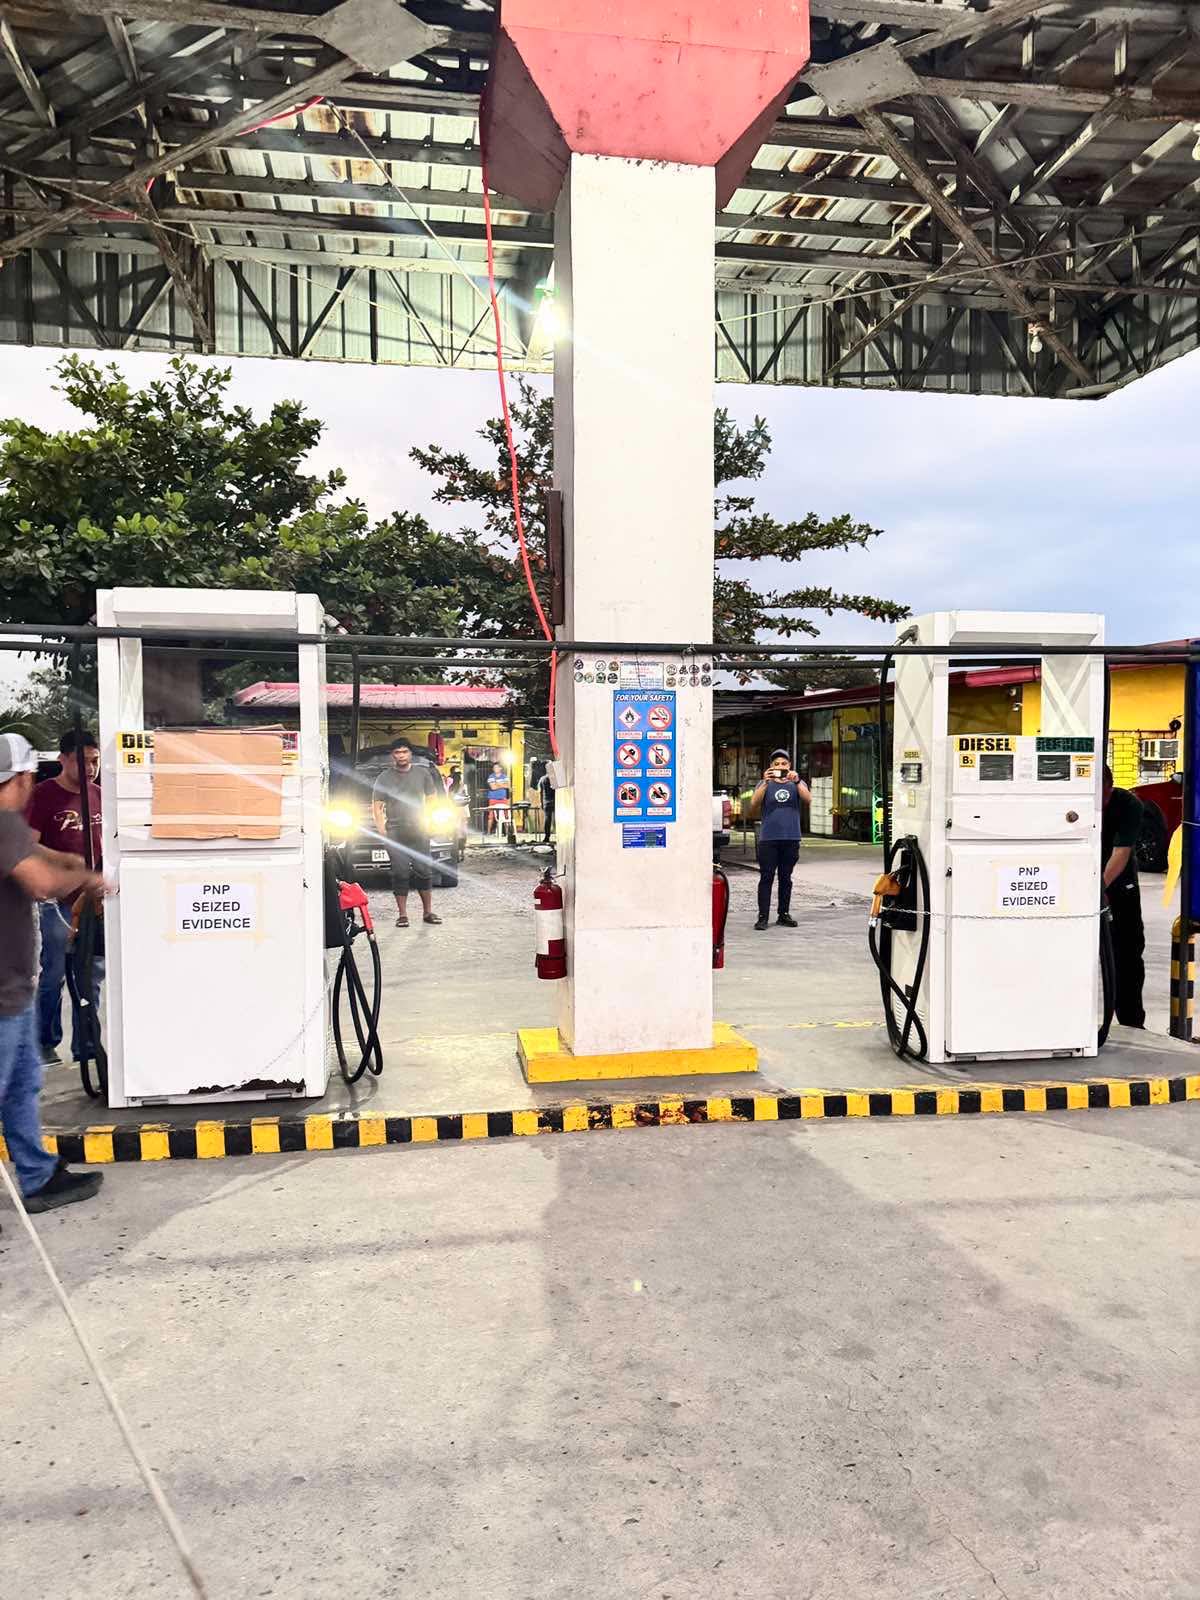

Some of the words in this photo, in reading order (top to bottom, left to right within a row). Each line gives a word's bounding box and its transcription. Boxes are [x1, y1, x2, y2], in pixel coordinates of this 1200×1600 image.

[649, 694, 673, 702] SAFETY
[959, 737, 1012, 752] DIESEL
[1018, 867, 1040, 876] PNP
[203, 884, 230, 895] PNP
[1010, 881, 1048, 891] SEIZED
[192, 901, 240, 912] SEIZED
[1002, 896, 1056, 907] EVIDENCE
[182, 918, 250, 930] EVIDENCE
